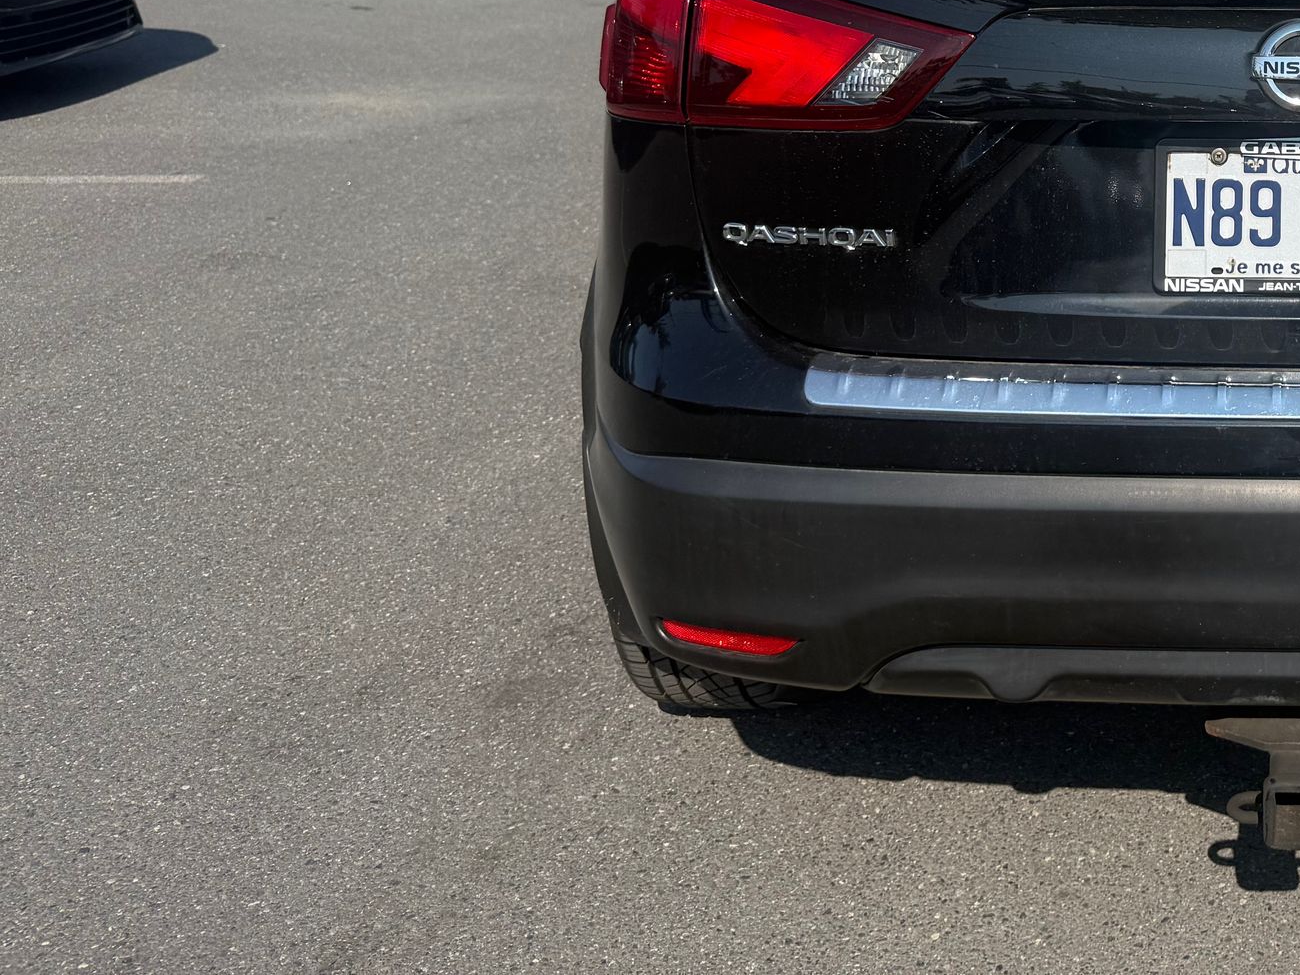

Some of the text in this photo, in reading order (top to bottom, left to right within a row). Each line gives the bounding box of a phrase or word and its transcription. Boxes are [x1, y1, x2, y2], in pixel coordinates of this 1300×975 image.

[1171, 177, 1282, 247] N89
[722, 222, 897, 251] QASHQAI
[1255, 262, 1284, 275] me
[1163, 277, 1245, 293] NISSAN
